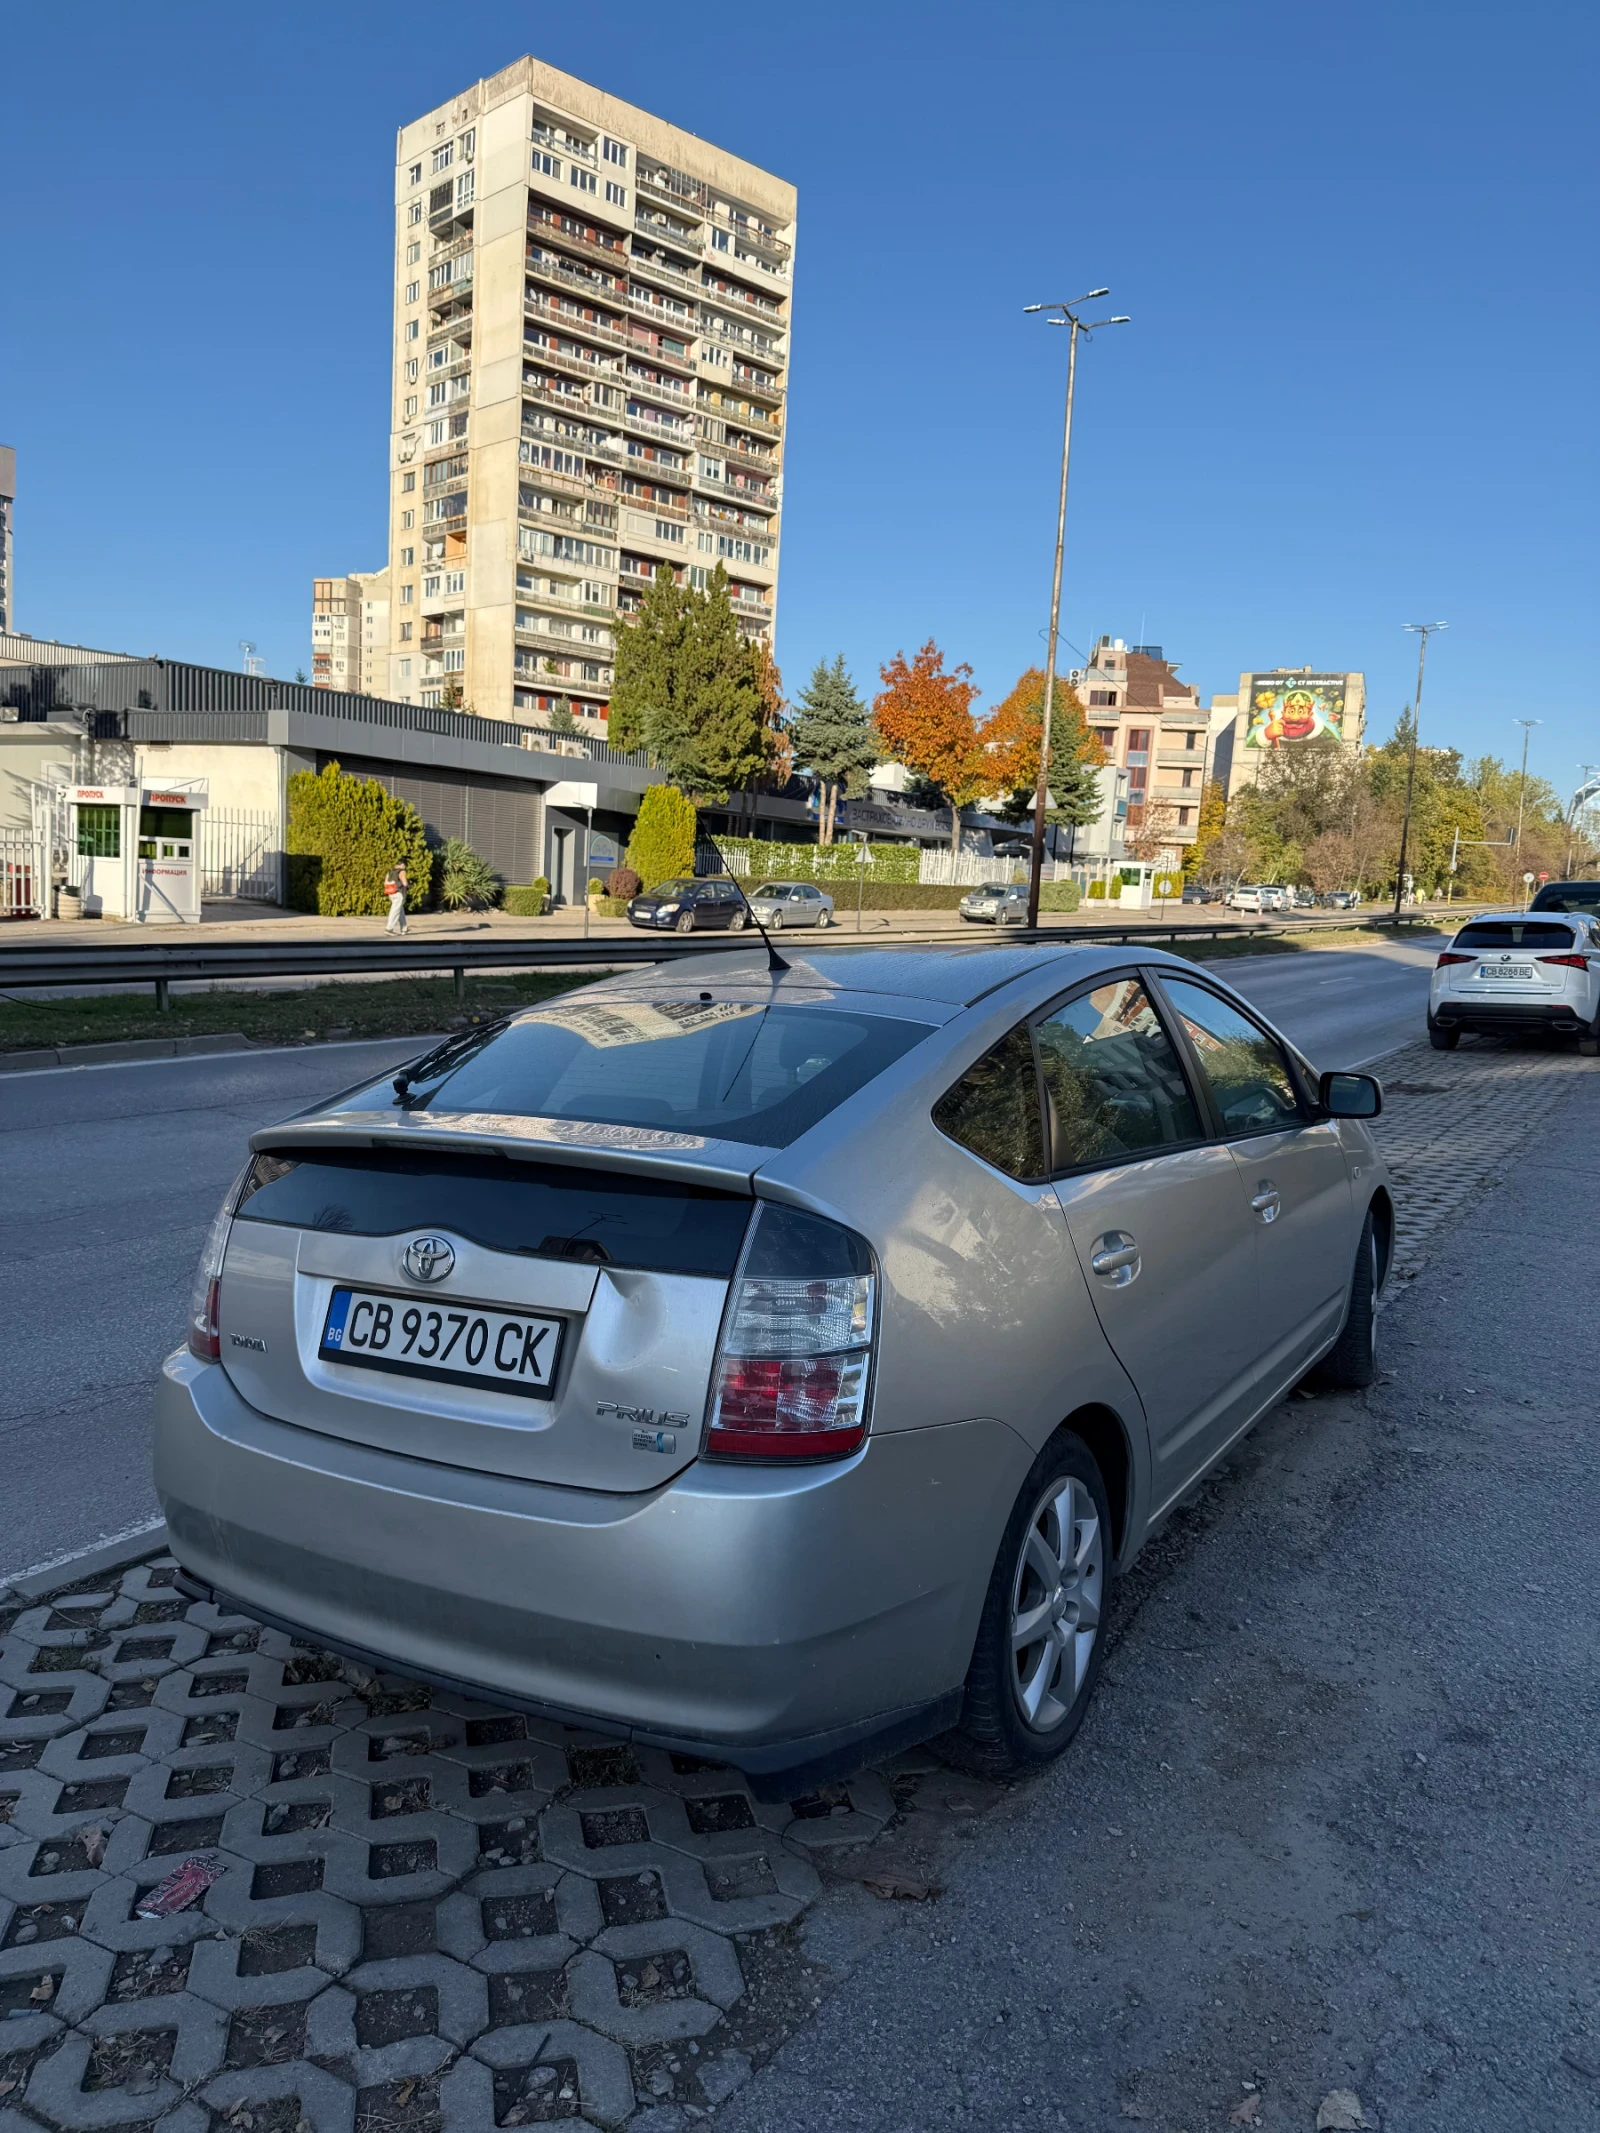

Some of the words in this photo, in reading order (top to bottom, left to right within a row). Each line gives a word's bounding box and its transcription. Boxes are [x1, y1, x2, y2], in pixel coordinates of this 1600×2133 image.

[77, 790, 104, 799] ПРОПУСК
[149, 793, 187, 804] ПРОПУСК
[141, 868, 188, 876] ИНФОРМАЦИЯ
[327, 1327, 342, 1342] BG
[349, 1301, 394, 1350] CB
[400, 1308, 489, 1366] 9370
[494, 1322, 550, 1377] CK
[230, 1333, 268, 1353] TOYOTA
[596, 1400, 690, 1428] PRIUS
